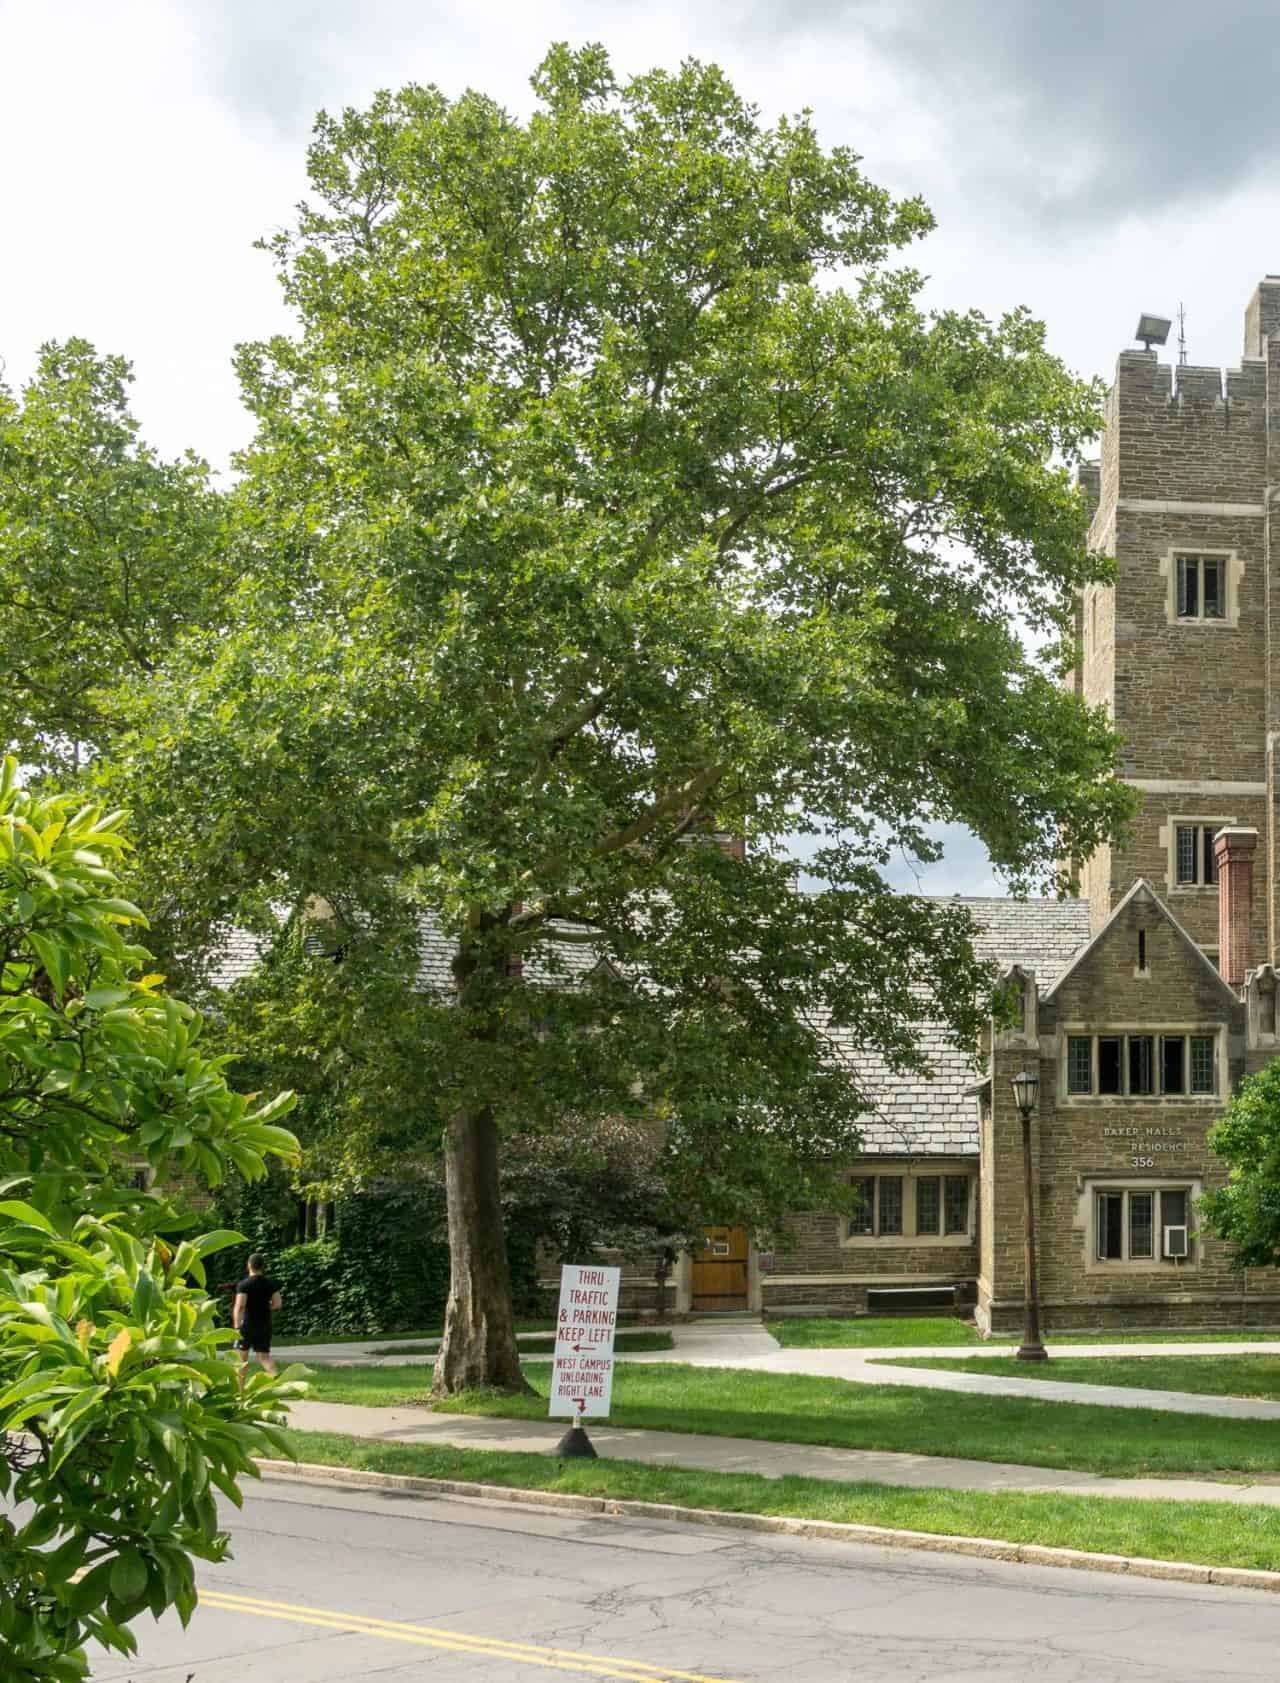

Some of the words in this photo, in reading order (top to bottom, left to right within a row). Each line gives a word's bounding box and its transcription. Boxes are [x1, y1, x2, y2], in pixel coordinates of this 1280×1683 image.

[1103, 1127, 1138, 1136] BAKER
[1131, 1156, 1154, 1168] 356
[578, 1270, 605, 1286] THRU
[569, 1289, 609, 1306] TRAFFIC
[559, 1308, 568, 1322] &
[573, 1309, 615, 1326] PARKING
[558, 1326, 585, 1342] KEEP
[588, 1327, 612, 1343] LEFT
[556, 1358, 577, 1369] WEST
[579, 1358, 611, 1370] CAMPUS
[560, 1371, 604, 1384] UNLOADING
[558, 1384, 580, 1396] RIGHT
[583, 1385, 604, 1398] LANE
